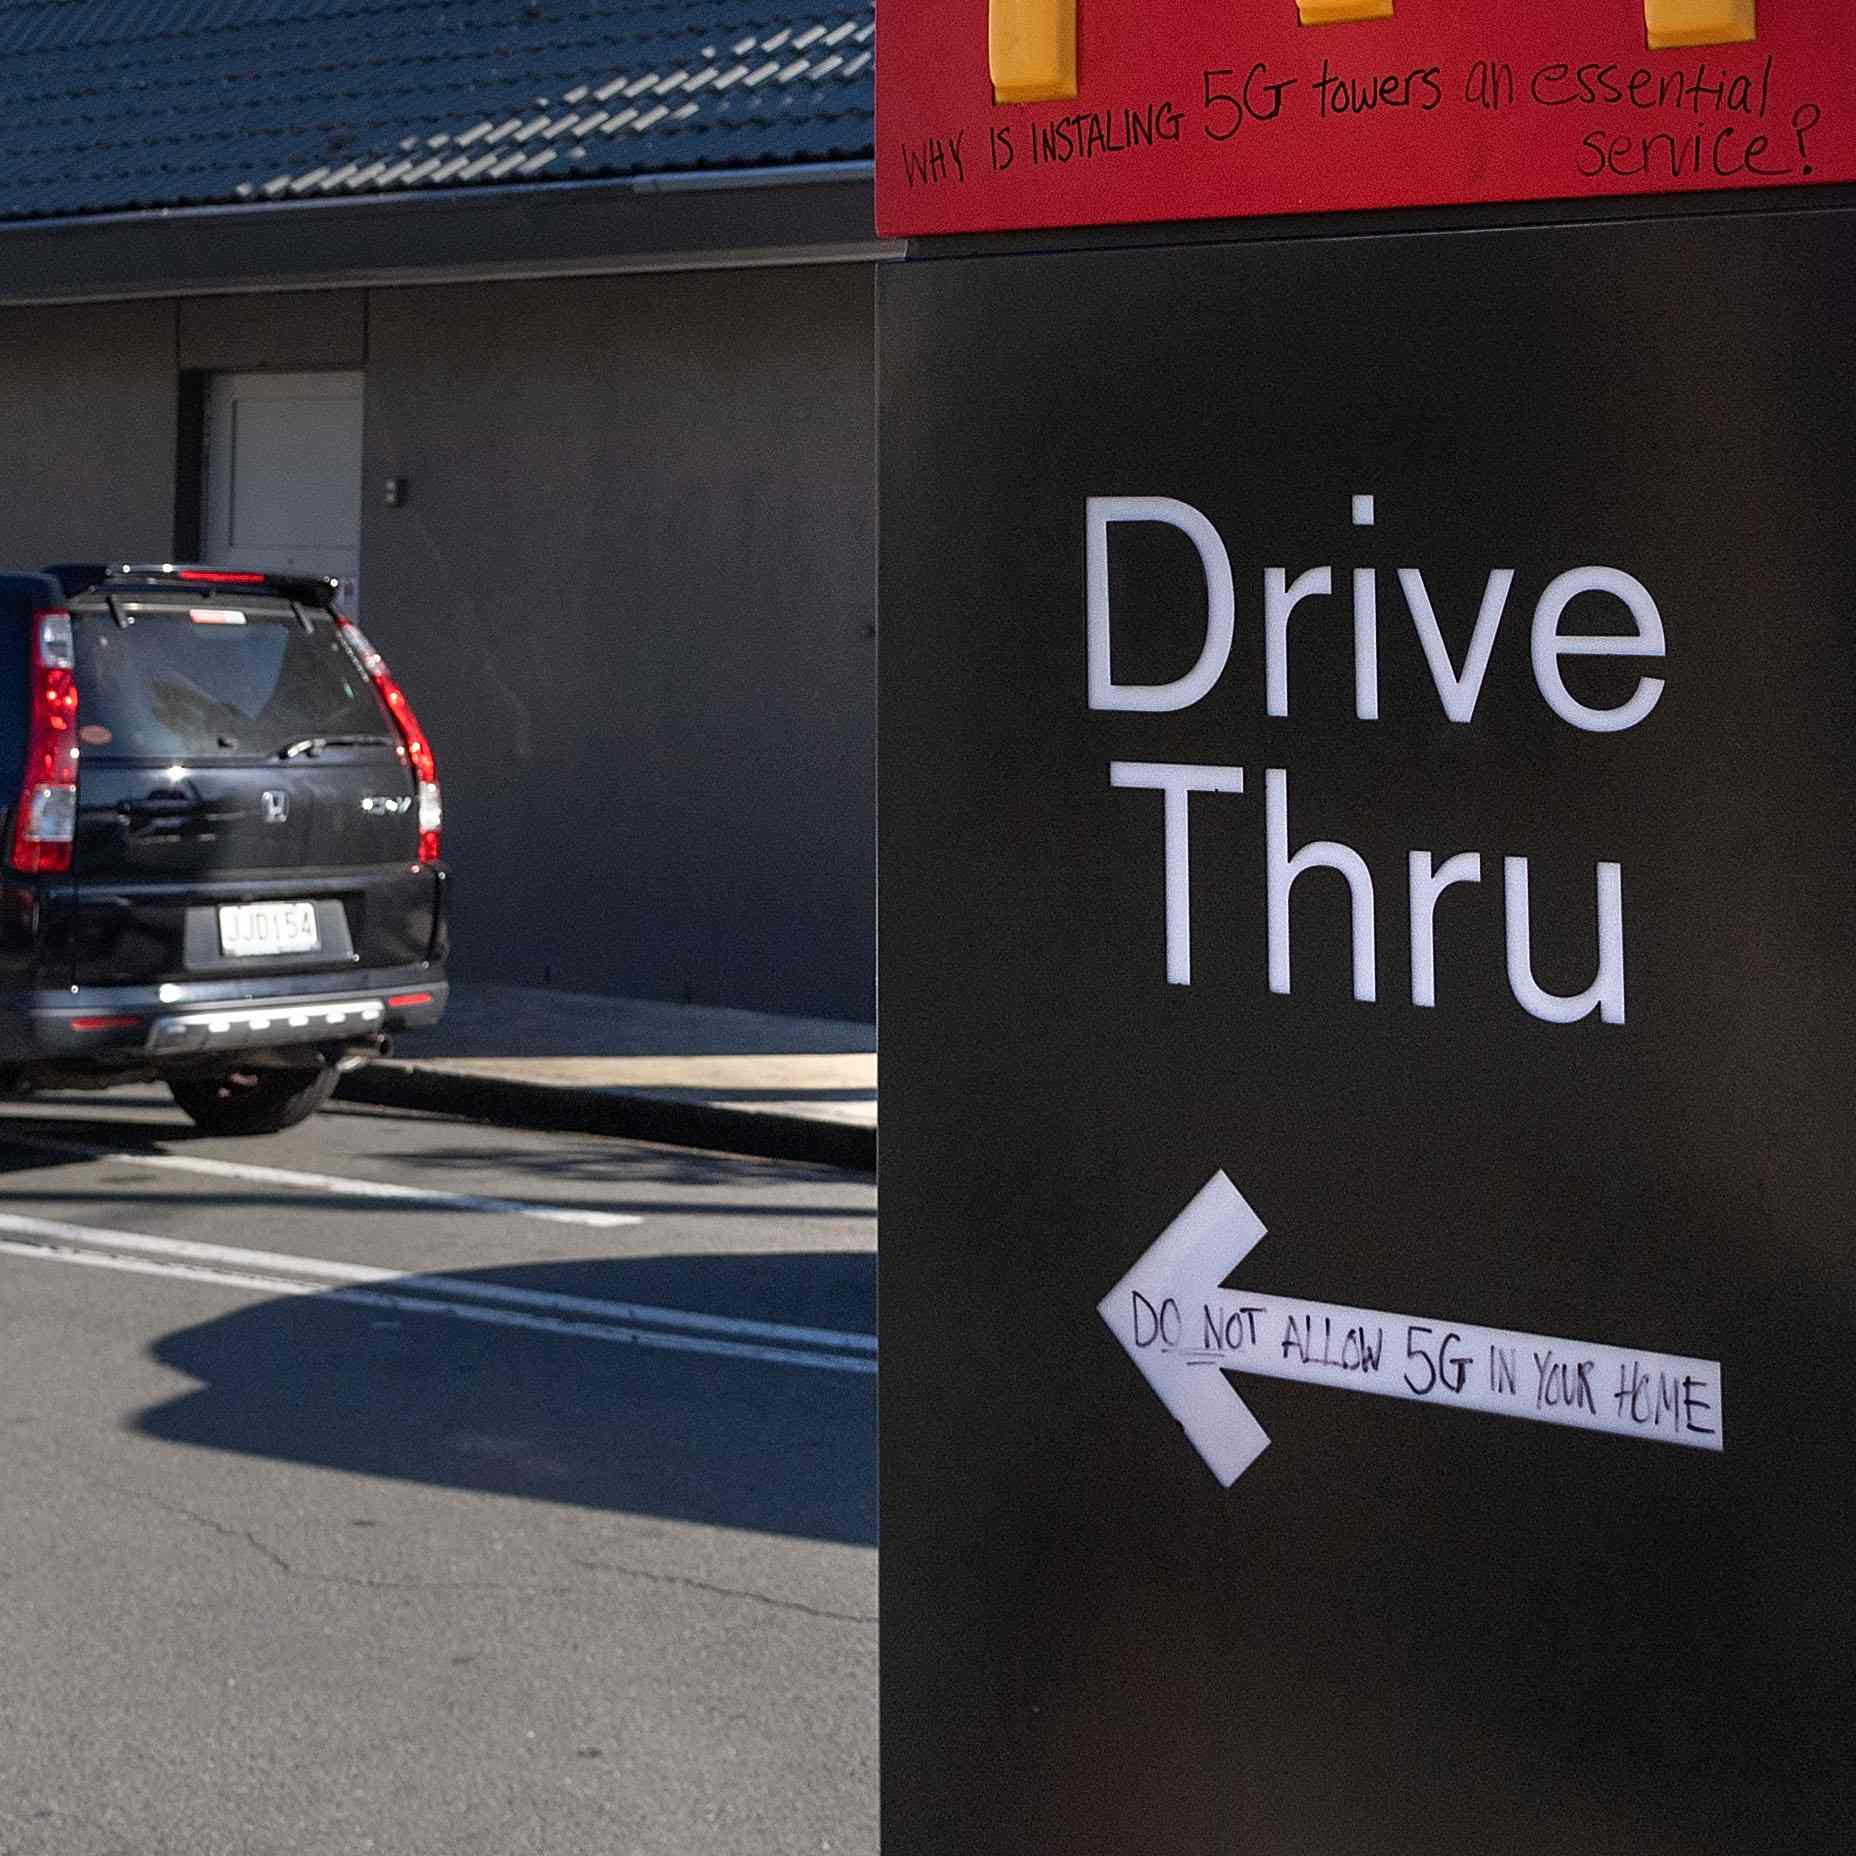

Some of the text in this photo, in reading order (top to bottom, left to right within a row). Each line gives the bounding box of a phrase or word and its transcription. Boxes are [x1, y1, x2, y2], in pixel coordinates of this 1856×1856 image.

[902, 54, 1773, 188] WHY IS INSTALING 5G towers an essential
[1086, 494, 1667, 733] Drive
[1110, 760, 1626, 1025] Thru
[1132, 1290, 1715, 1434] DO NOT ALLOW 5G IN YOUR HOME
